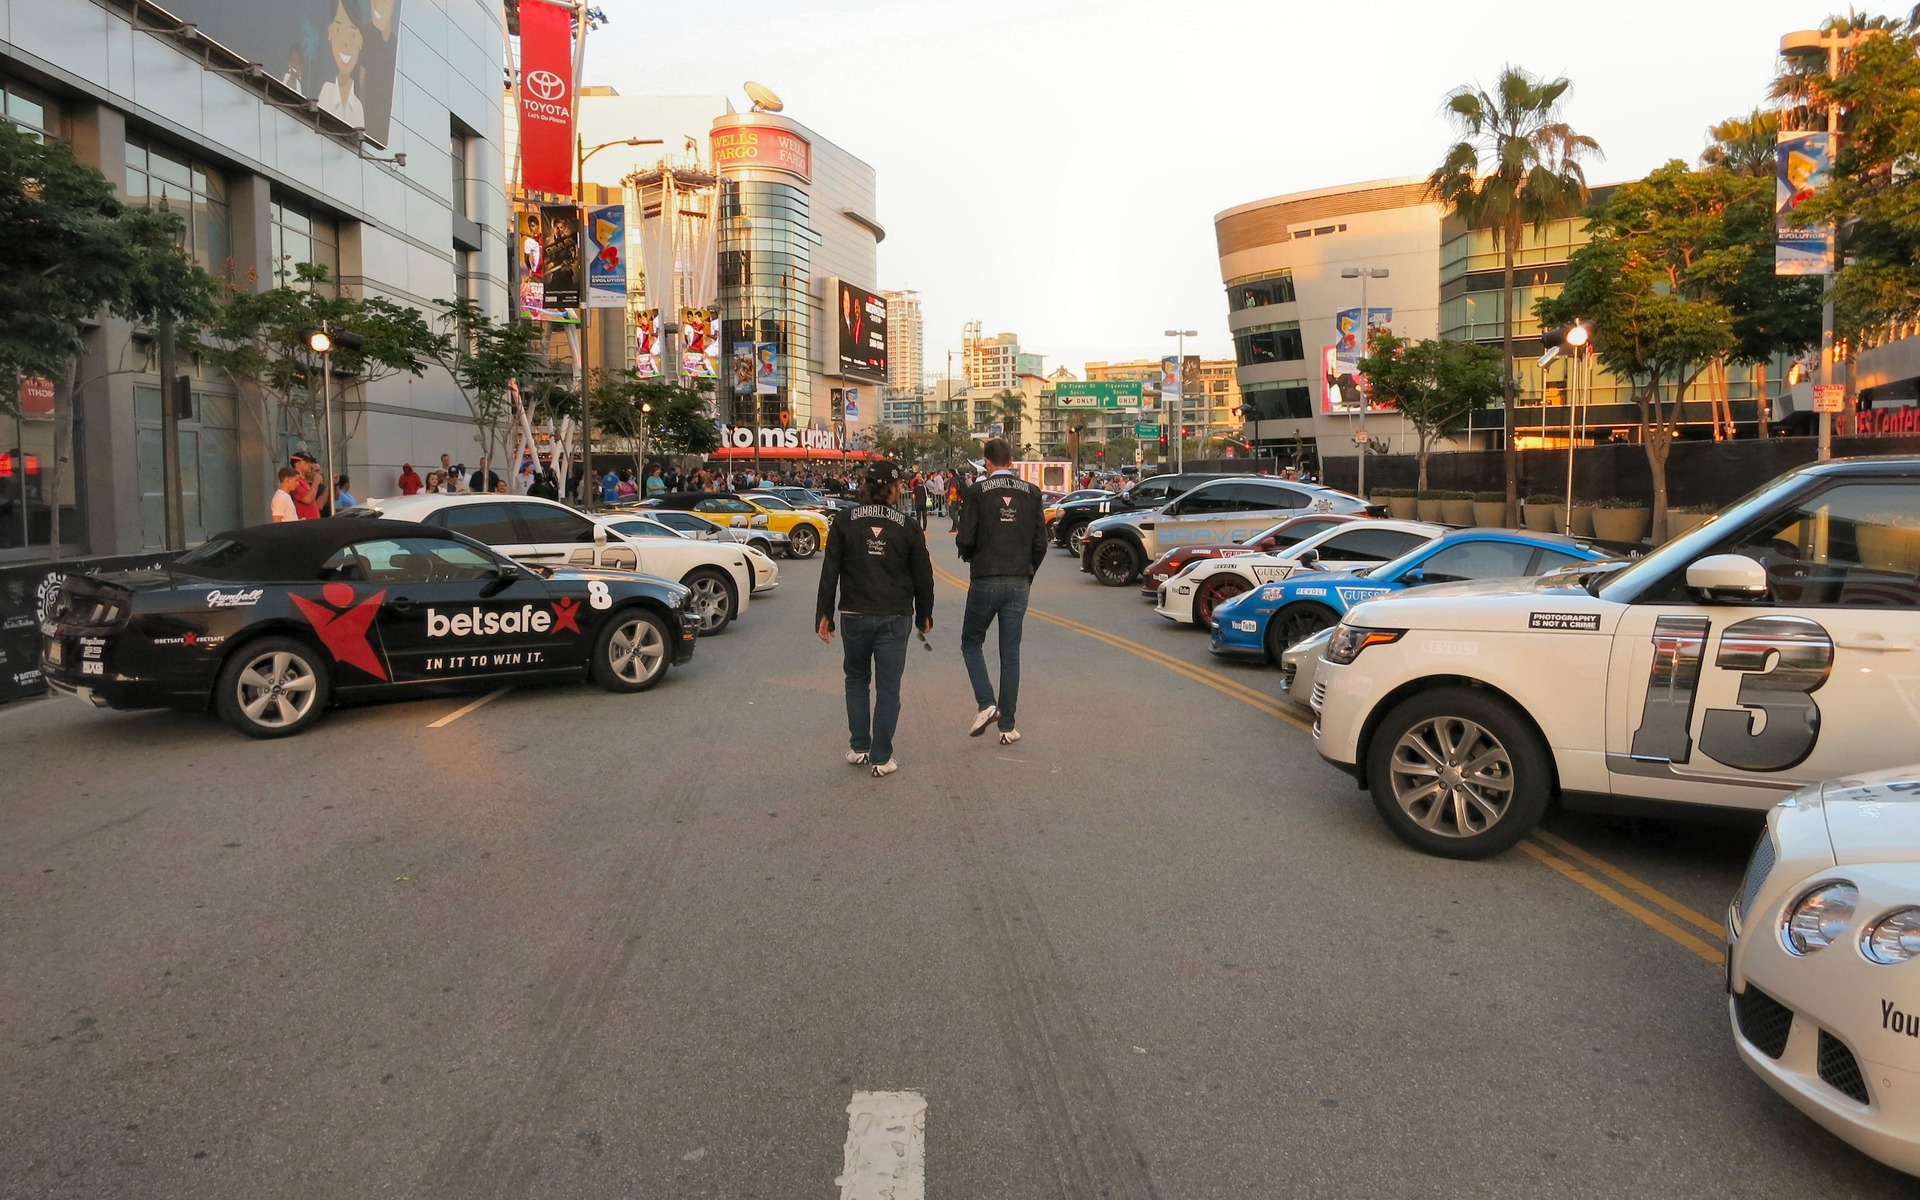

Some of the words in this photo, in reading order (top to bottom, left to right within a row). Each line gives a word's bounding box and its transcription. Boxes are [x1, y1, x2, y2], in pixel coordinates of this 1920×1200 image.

[523, 99, 570, 118] TOYOTA
[527, 112, 540, 120] Let's
[549, 116, 567, 125] Places
[713, 133, 758, 149] WELLS
[778, 135, 806, 158] WELLS
[714, 146, 758, 161] FARGO
[779, 149, 806, 169] FARGO
[1875, 406, 1920, 435] Center
[721, 423, 798, 448] toms
[800, 424, 834, 449] urban
[982, 479, 1011, 492] GUMBALL
[1011, 480, 1029, 492] 3000
[827, 500, 836, 510] 10
[852, 504, 886, 519] GUMBALL
[886, 508, 904, 526] 3000
[1256, 567, 1286, 577] GUESS
[207, 589, 264, 608] Gumball
[587, 581, 613, 610] 8
[427, 604, 551, 638] betsafe
[1533, 613, 1597, 622] PHOTOGRAPHY
[1542, 620, 1560, 628] NOT
[1569, 621, 1597, 629] CRIME
[196, 635, 225, 643] #BETSAFE
[1423, 640, 1478, 654] REVOLT
[426, 658, 443, 671] IN
[449, 656, 466, 669] IT
[470, 654, 488, 667] TO
[493, 652, 521, 666] WIN
[526, 651, 545, 664] IT.
[1630, 614, 1835, 773] 13
[1881, 998, 1920, 1038] You
